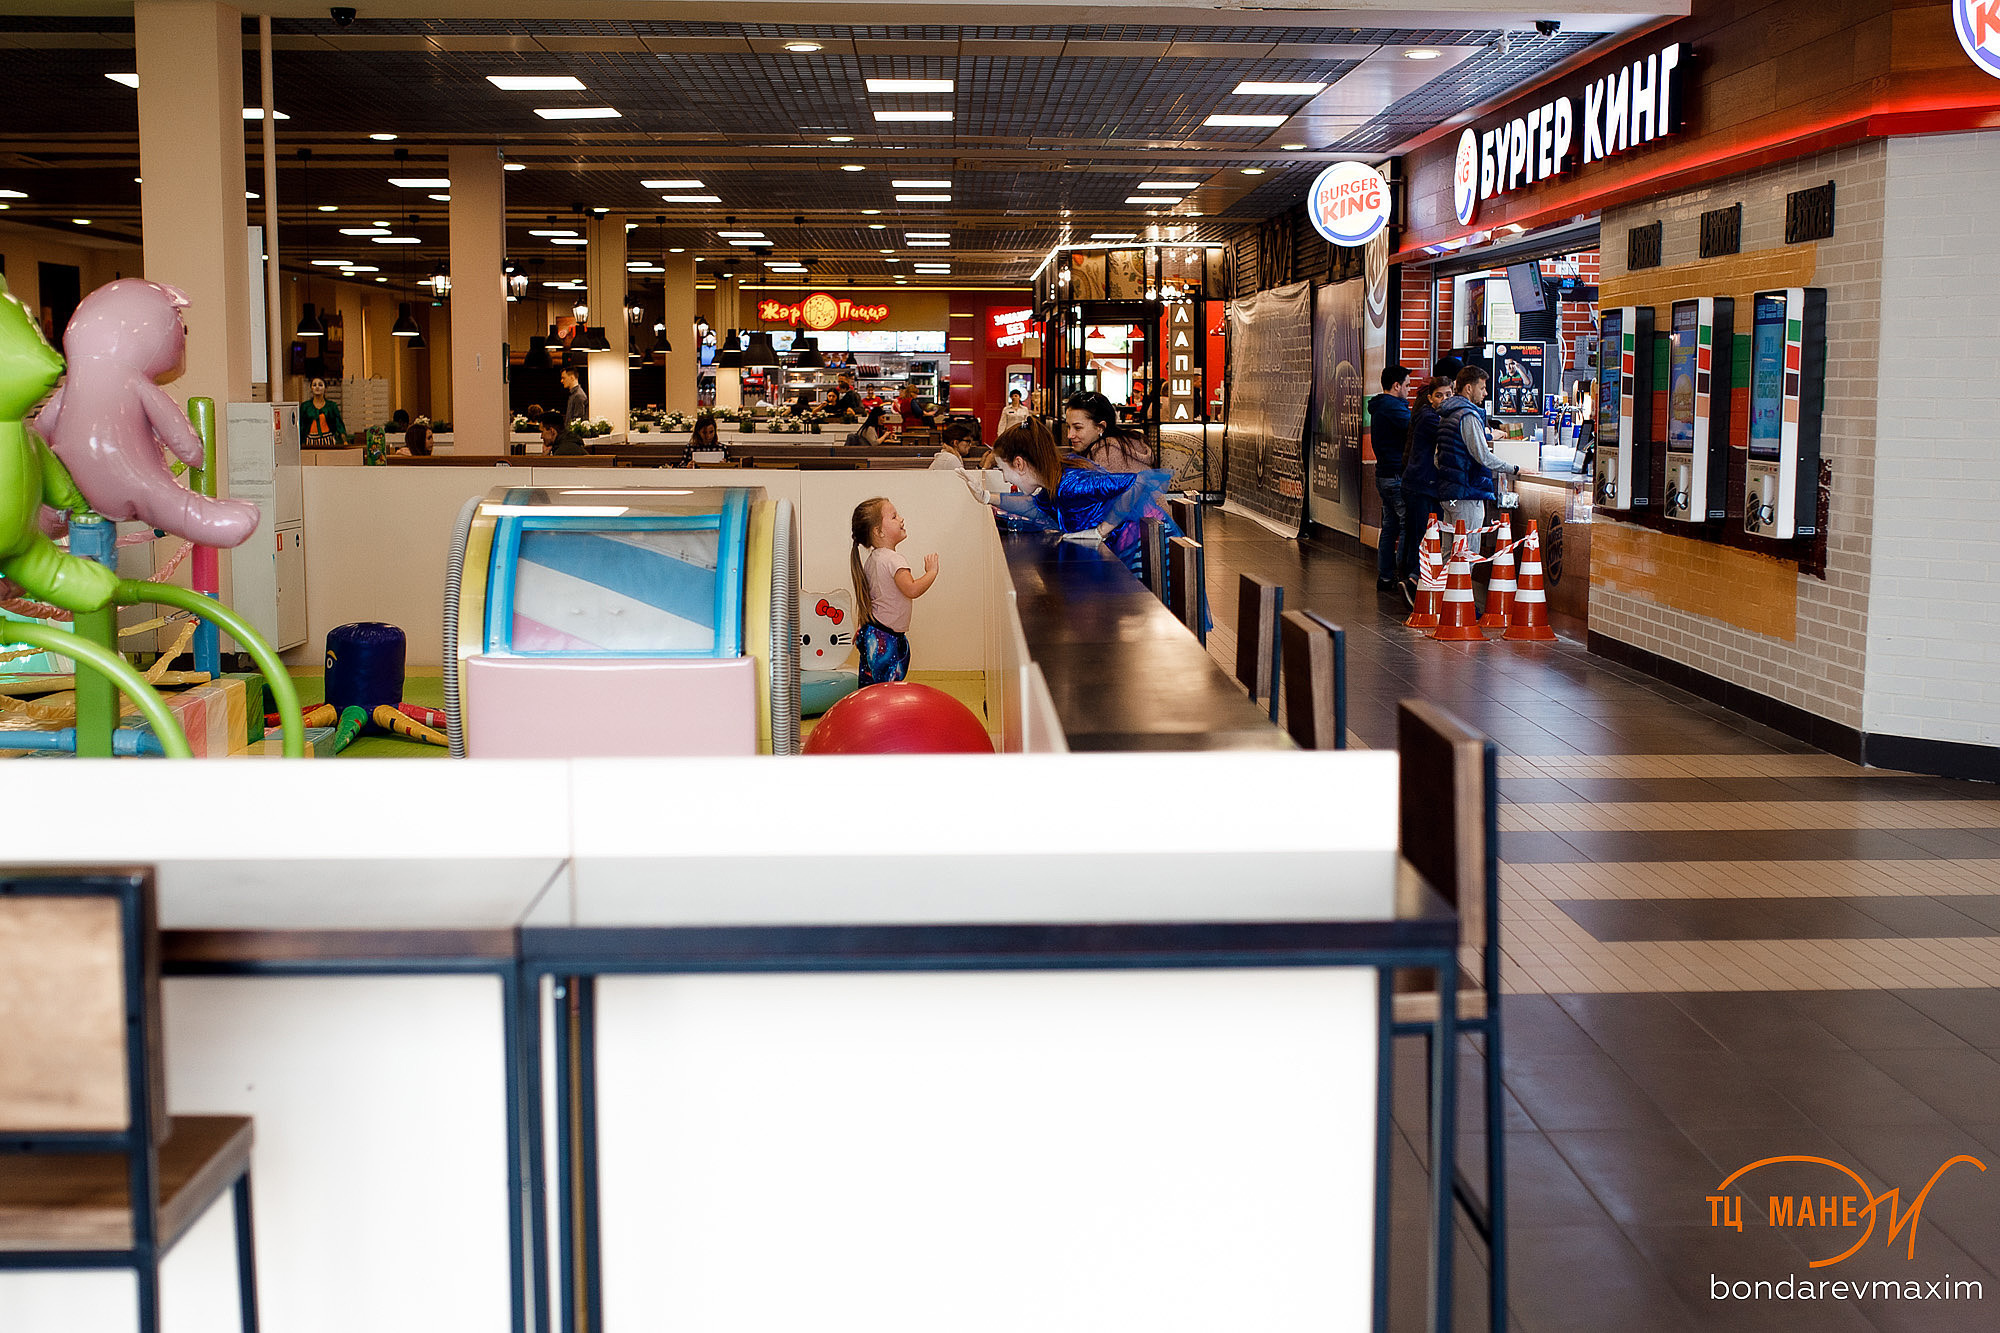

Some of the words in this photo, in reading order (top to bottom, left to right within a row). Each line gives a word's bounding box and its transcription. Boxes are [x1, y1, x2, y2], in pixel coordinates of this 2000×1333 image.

[1480, 96, 1573, 200] БУРГЕР
[1584, 43, 1679, 164] КИНГ
[1320, 177, 1378, 205] BURGER
[1322, 191, 1381, 226] KING
[760, 302, 801, 324] Жар
[839, 302, 889, 321] Пицца
[1172, 306, 1191, 420] ЛАПША
